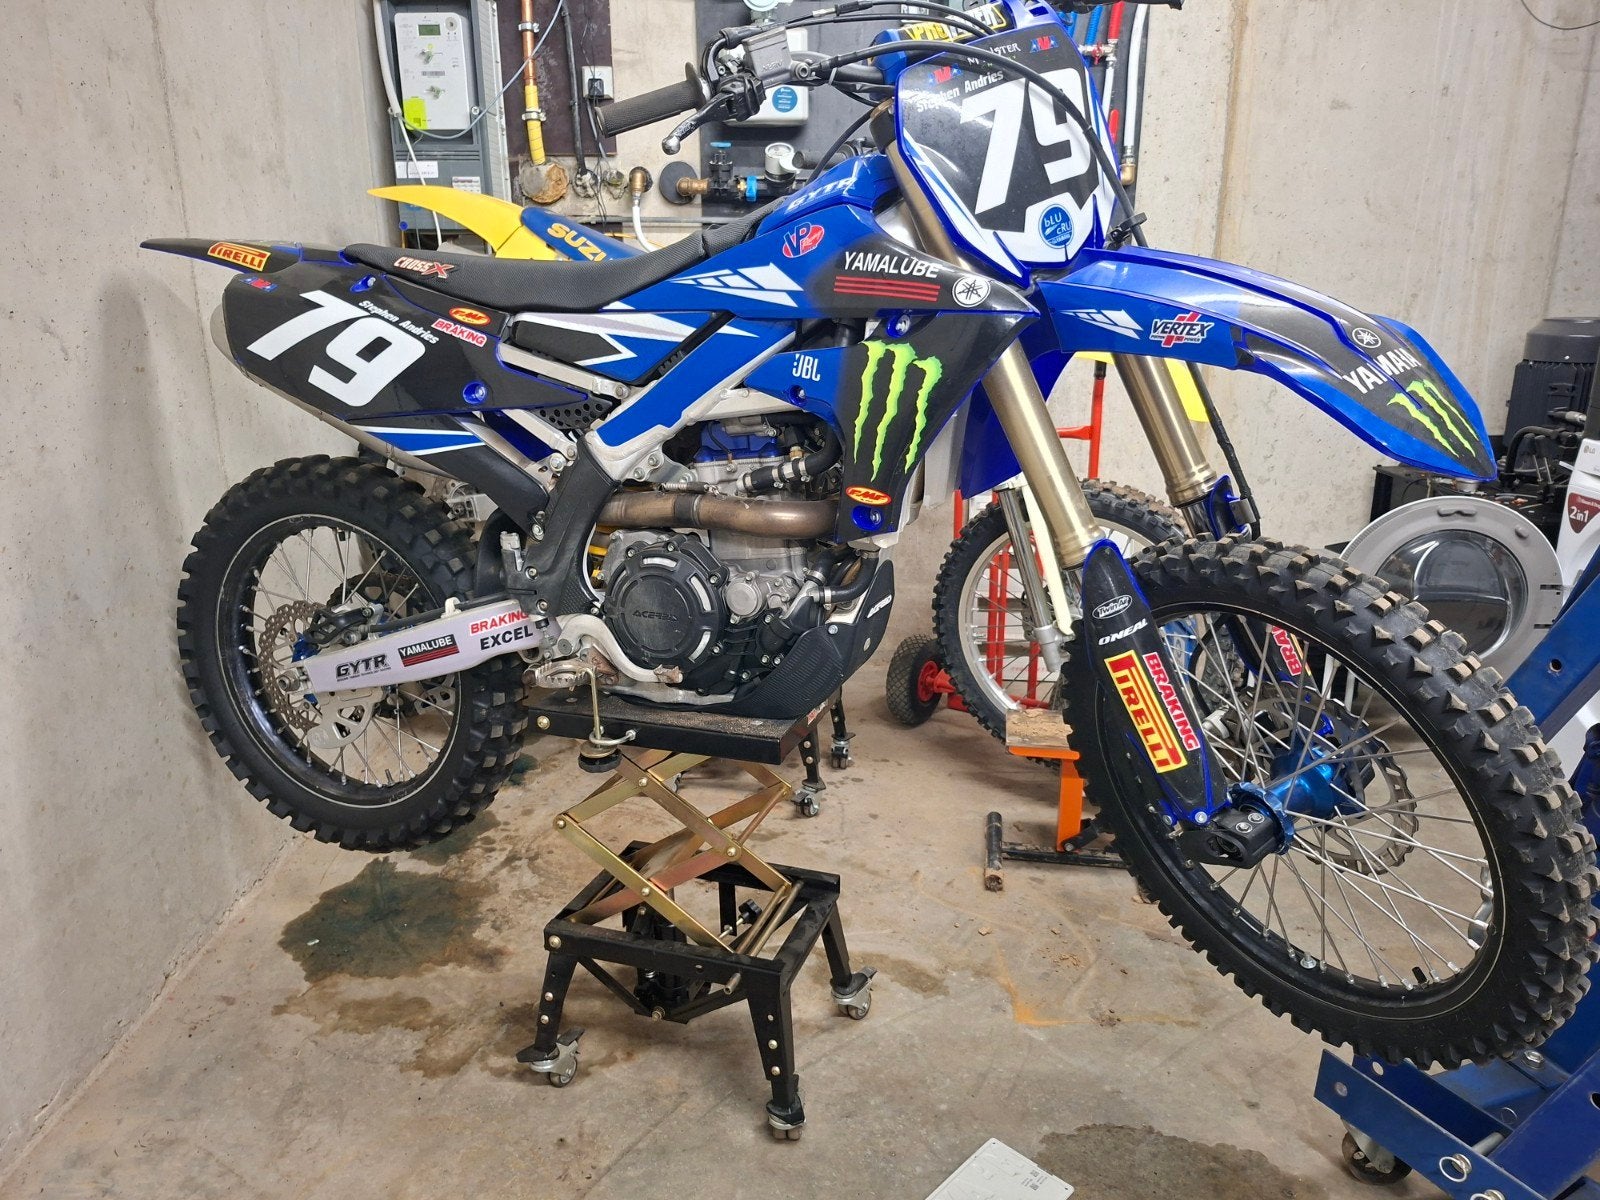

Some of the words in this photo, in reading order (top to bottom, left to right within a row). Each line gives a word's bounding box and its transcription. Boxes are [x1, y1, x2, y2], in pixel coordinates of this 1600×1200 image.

[967, 42, 1022, 66] MSTER
[964, 70, 1004, 93] Andries
[960, 68, 1092, 215] 79
[209, 242, 268, 269] PIRELLI
[843, 251, 942, 279] YAMALUBE
[358, 300, 400, 323] Stephen
[399, 320, 440, 345] Andries
[433, 320, 486, 346] BRAKING
[1152, 320, 1213, 337] VERTEX
[246, 289, 426, 407] 79
[792, 353, 821, 382] JBL
[399, 634, 453, 657] YAMALUBE
[480, 624, 534, 651] EXCEL
[335, 653, 389, 679] GYTR
[1107, 653, 1182, 769] PIRELLI
[1144, 653, 1200, 750] BRAKING
